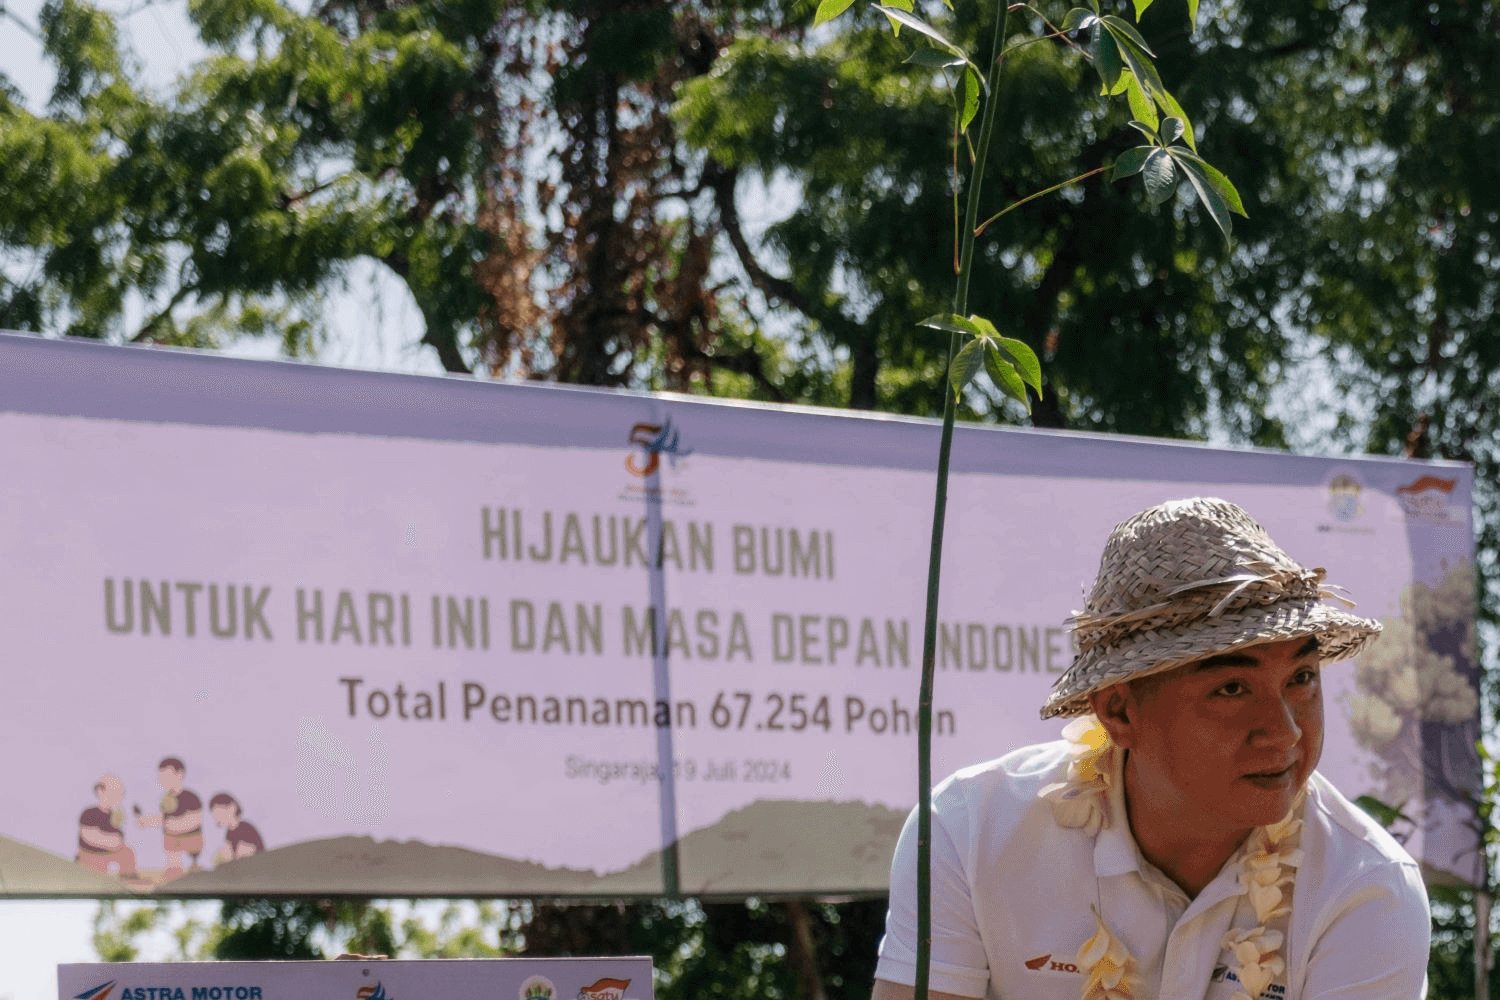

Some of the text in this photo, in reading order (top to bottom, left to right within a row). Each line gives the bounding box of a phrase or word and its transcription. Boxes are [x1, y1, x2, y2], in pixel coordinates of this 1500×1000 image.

[479, 505, 836, 582] HIJAUKAN BUMI
[103, 577, 275, 641] UNTUK
[295, 587, 411, 648] HARI
[430, 594, 491, 650] INI
[508, 599, 604, 656] DAN
[622, 604, 755, 662] MASA
[772, 612, 911, 668] DEPAN
[339, 676, 446, 722] Total
[461, 682, 698, 730] Penanaman
[710, 689, 832, 732] 67.254
[703, 760, 738, 783] Juli
[743, 759, 793, 784] 2024
[191, 986, 263, 1000] MOTOR
